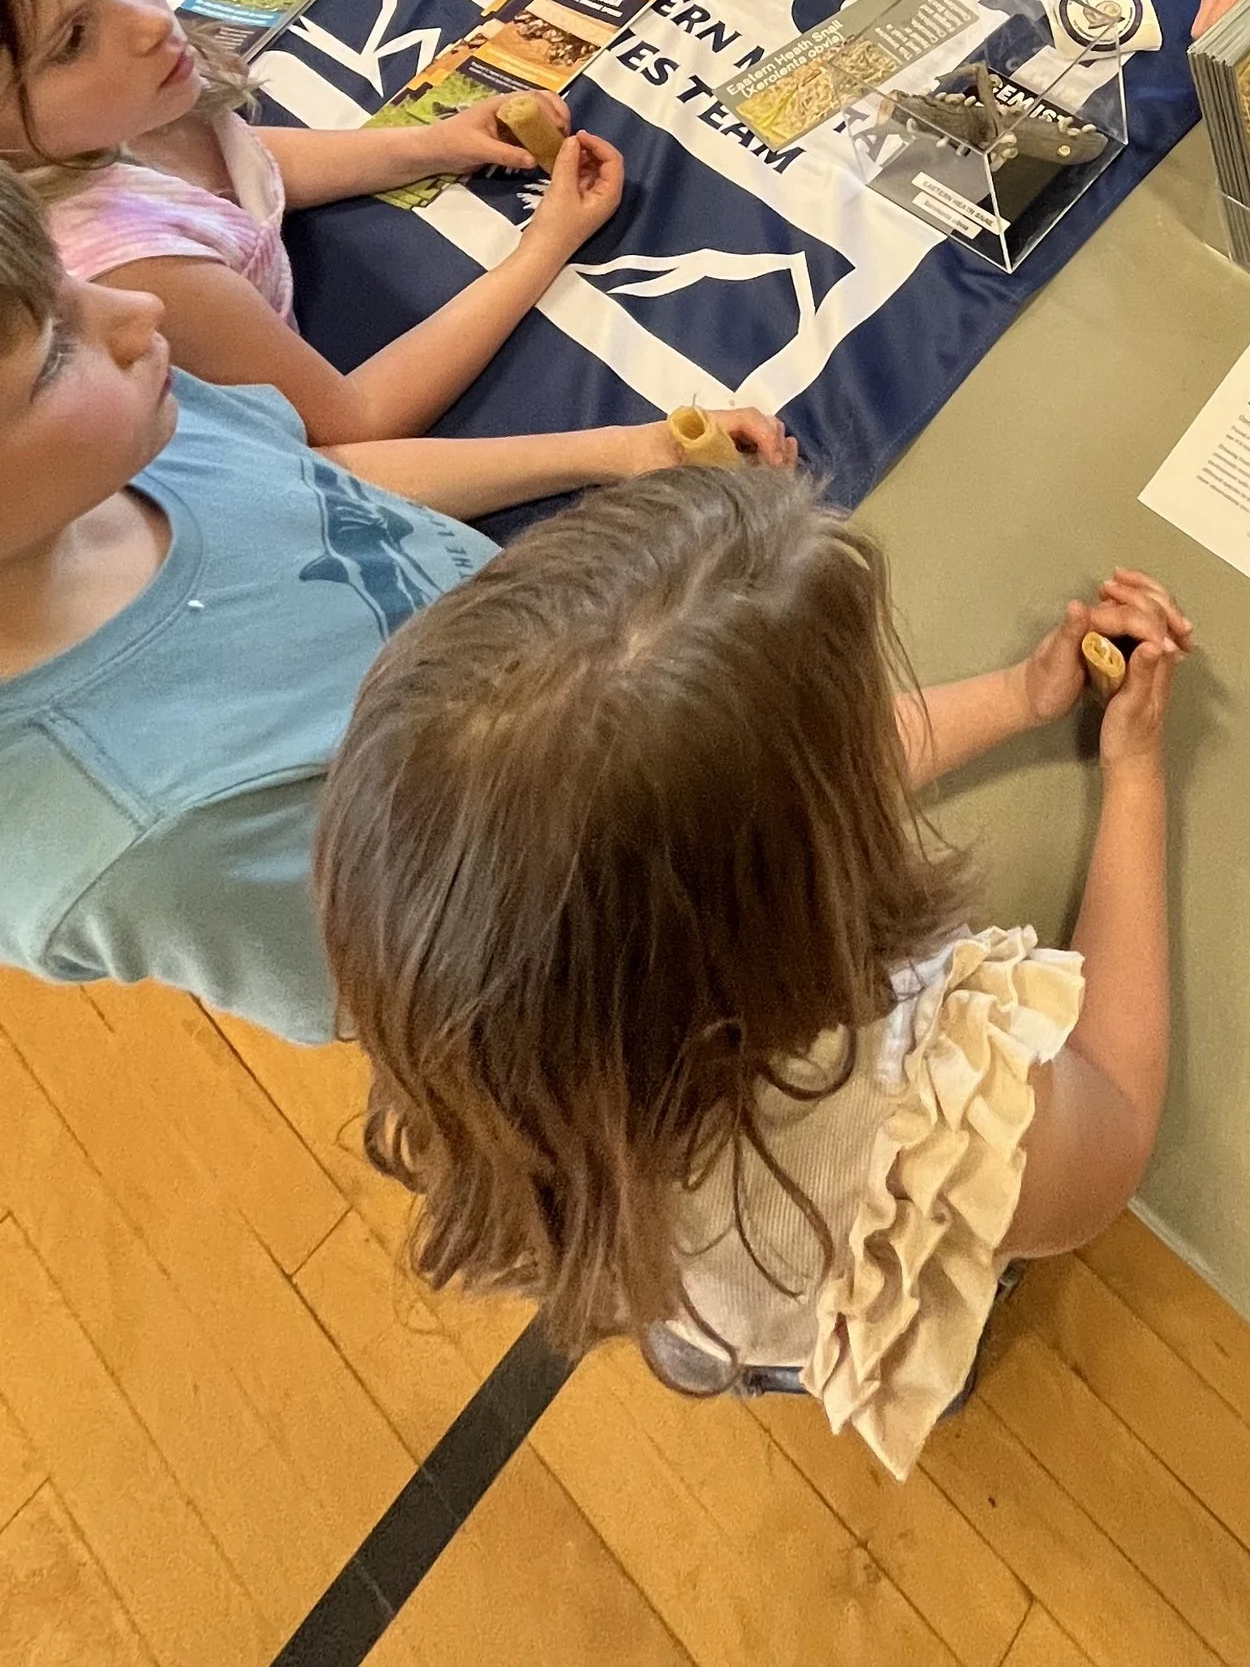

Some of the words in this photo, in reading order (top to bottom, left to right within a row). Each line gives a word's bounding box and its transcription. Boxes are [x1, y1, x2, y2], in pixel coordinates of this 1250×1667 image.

[727, 62, 776, 96] Eastern
[774, 38, 814, 65] Heath
[811, 19, 843, 43] Snail
[741, 55, 807, 99] (Xerolenta
[807, 30, 845, 58] obvia)
[676, 74, 807, 174] TEAM
[922, 180, 953, 201] EASTERN
